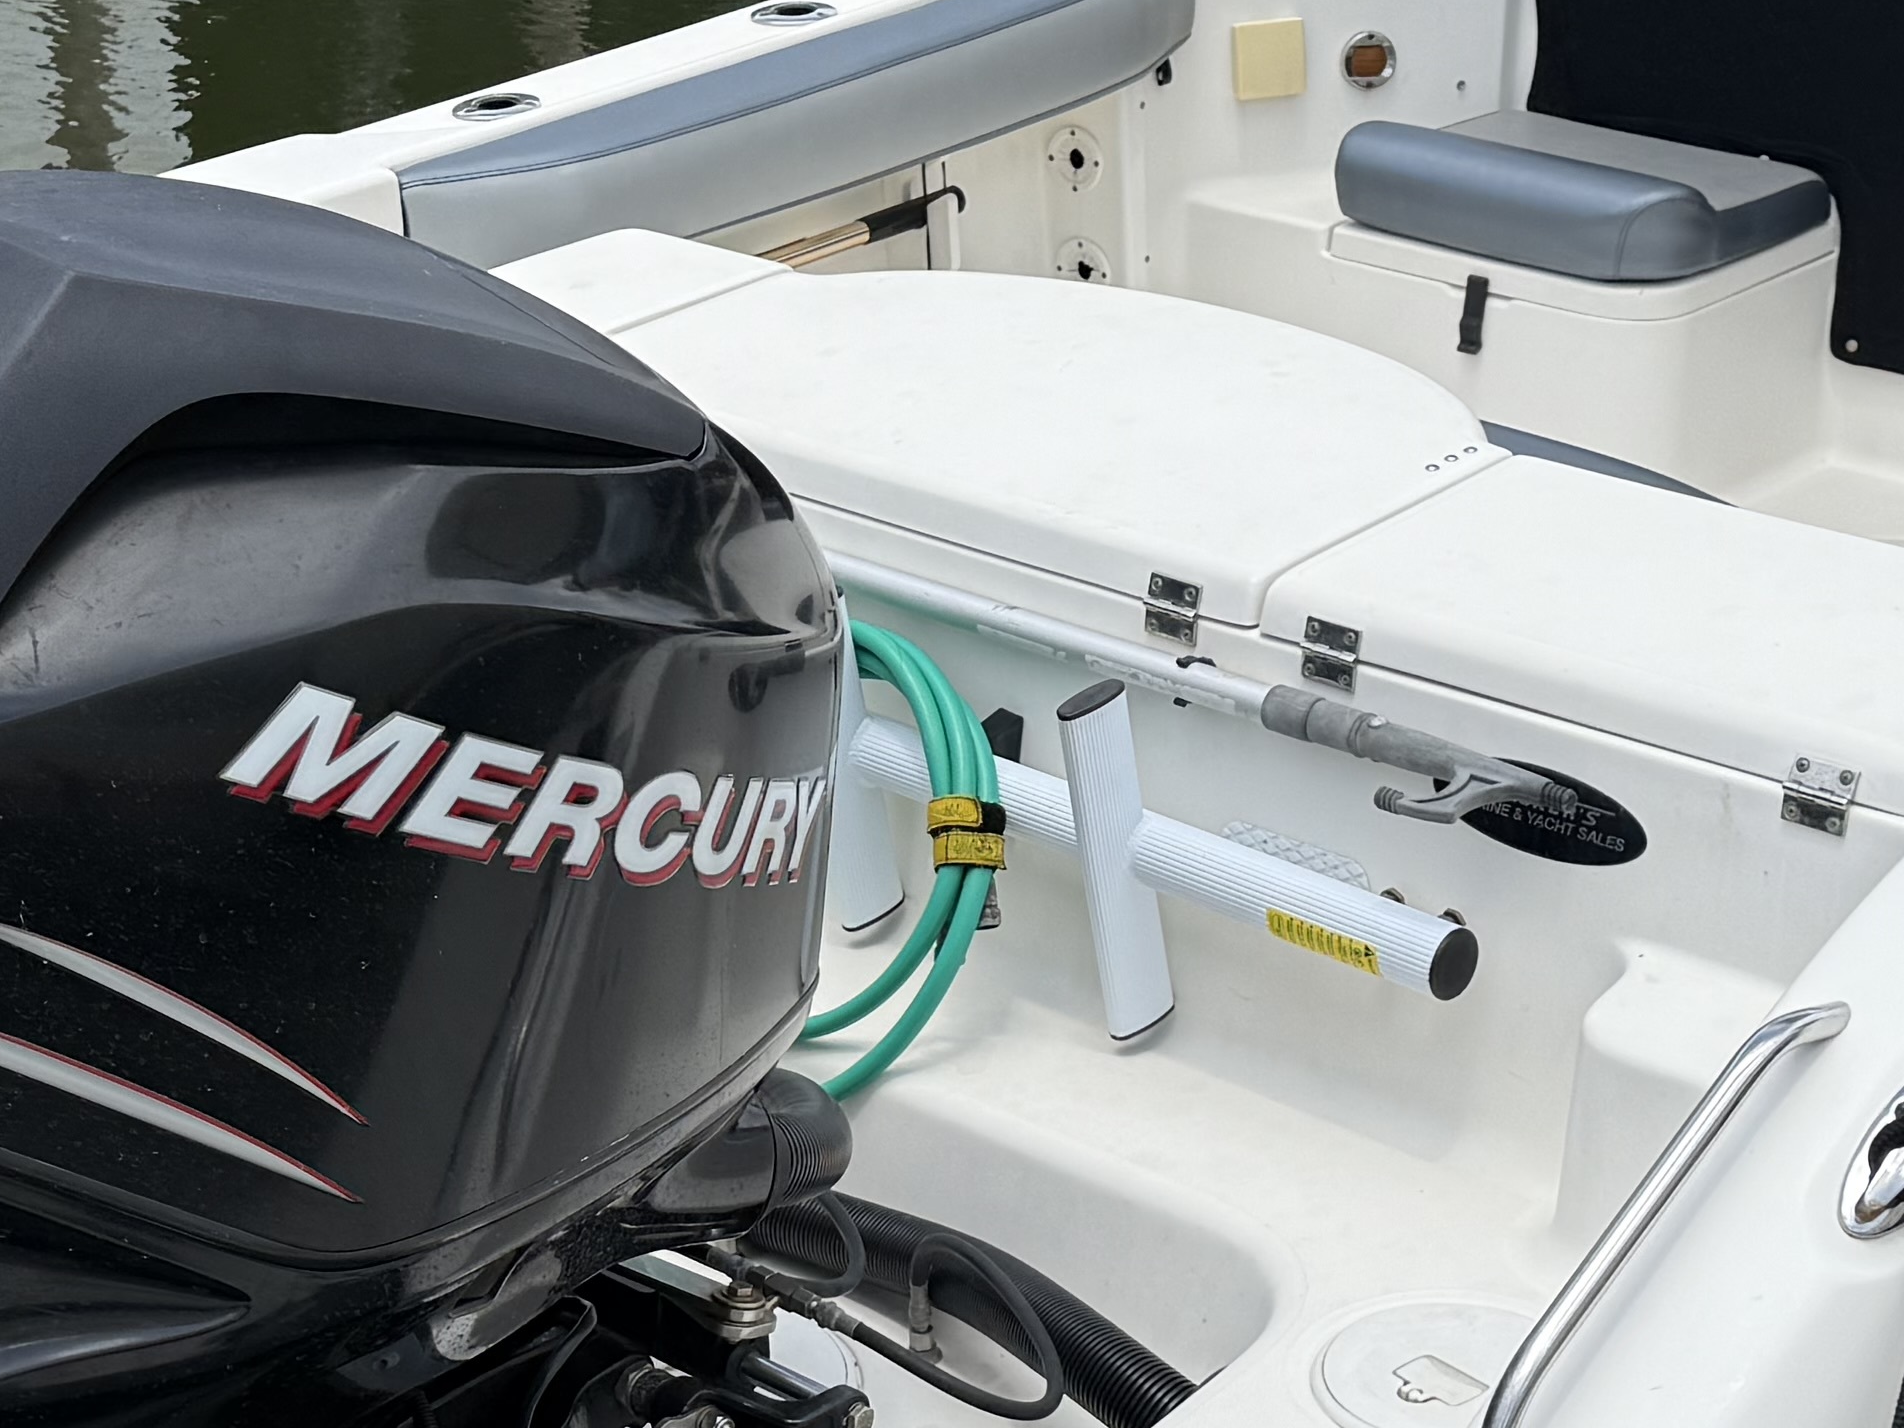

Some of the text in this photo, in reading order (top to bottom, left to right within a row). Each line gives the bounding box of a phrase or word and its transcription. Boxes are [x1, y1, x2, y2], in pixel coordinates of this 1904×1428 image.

[218, 680, 829, 890] MERCURY
[1512, 807, 1522, 821] &
[1526, 810, 1577, 837] YACHT
[1576, 826, 1626, 852] SALES
